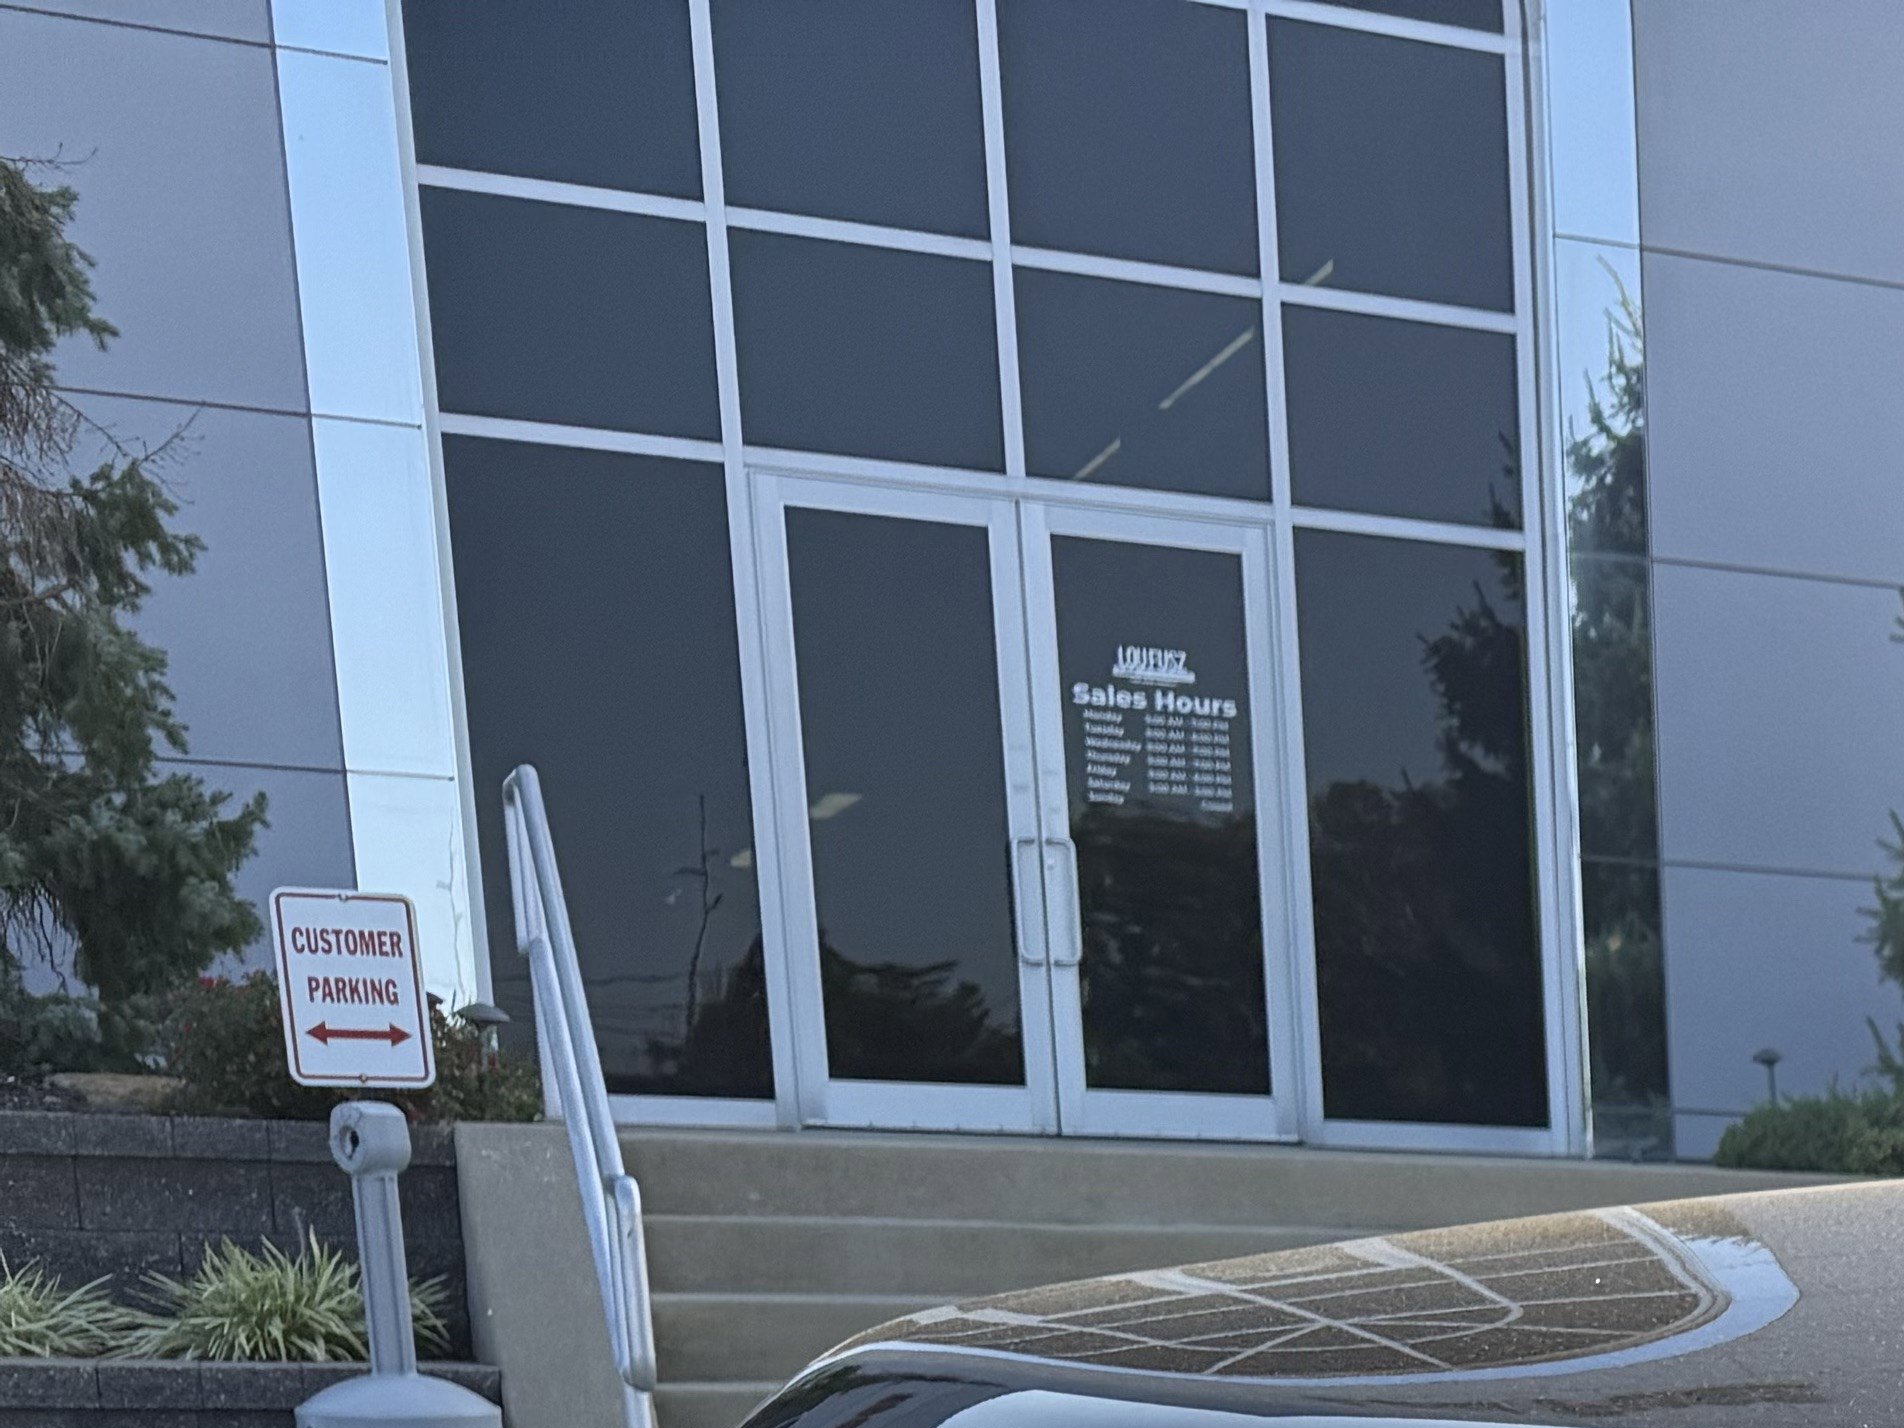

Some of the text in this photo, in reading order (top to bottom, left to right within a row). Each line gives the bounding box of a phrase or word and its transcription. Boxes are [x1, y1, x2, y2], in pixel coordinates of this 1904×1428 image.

[1072, 682, 1237, 717] Sales Hours
[291, 926, 404, 958] CUSTOMER
[307, 976, 400, 1006] PARKING
